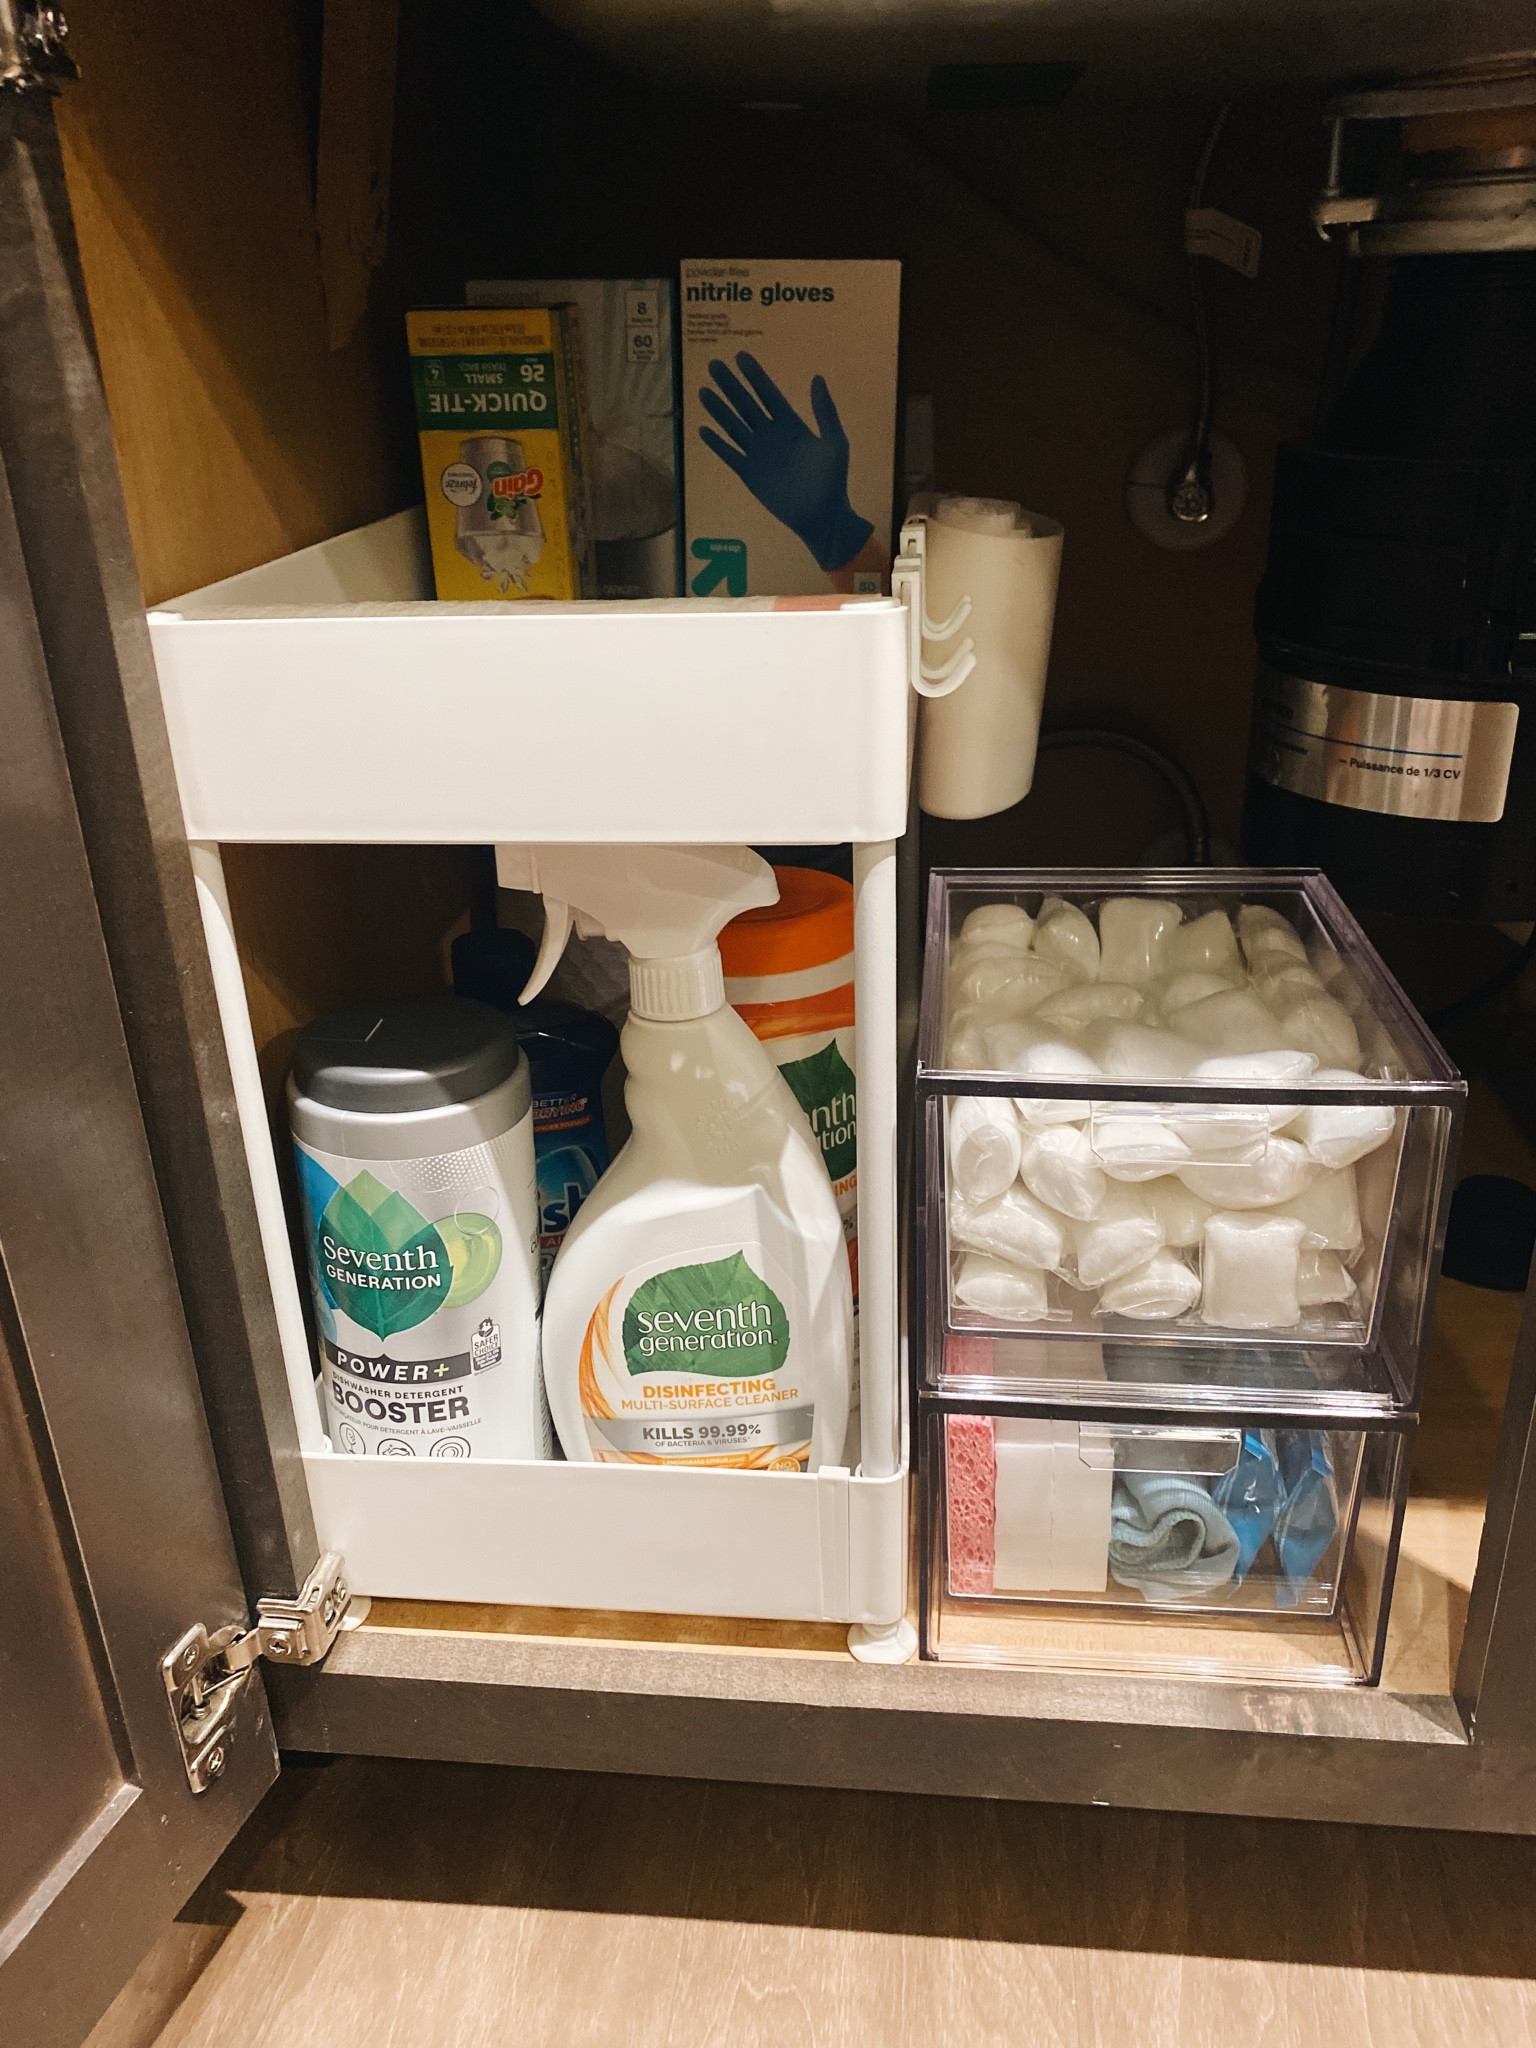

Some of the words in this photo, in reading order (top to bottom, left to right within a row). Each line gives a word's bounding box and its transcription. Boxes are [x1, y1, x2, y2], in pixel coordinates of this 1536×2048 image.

[686, 281, 753, 302] nitrile
[760, 281, 835, 306] gloves
[633, 334, 653, 348] 60
[463, 373, 504, 384] SMALL
[520, 364, 546, 383] 26
[428, 389, 547, 413] QUICK-TIE
[493, 467, 544, 500] Gain
[1350, 757, 1404, 775] Puissance
[1406, 766, 1420, 776] de
[1424, 768, 1441, 778] 1/3
[1443, 769, 1461, 779] CV
[323, 1236, 440, 1271] Seventh
[326, 1264, 441, 1291] GENERATION
[637, 1300, 772, 1334] seventh
[473, 1333, 499, 1350] SAFER
[474, 1341, 499, 1357] CHOICE
[332, 1371, 392, 1399] DISHWASHER
[394, 1385, 464, 1400] DETERGENT
[642, 1378, 776, 1399] DISINFECTING
[332, 1379, 470, 1425] BOOSTER
[621, 1395, 732, 1410] MULTI-SURFACE
[735, 1388, 798, 1405] CLEANER
[362, 1421, 380, 1431] POUR
[427, 1417, 483, 1435] LAVE-VAISSELLE
[642, 1426, 695, 1441] KILLS
[698, 1423, 761, 1439] 99.99%
[655, 1440, 666, 1448] OF
[668, 1439, 706, 1447] BACTERIA
